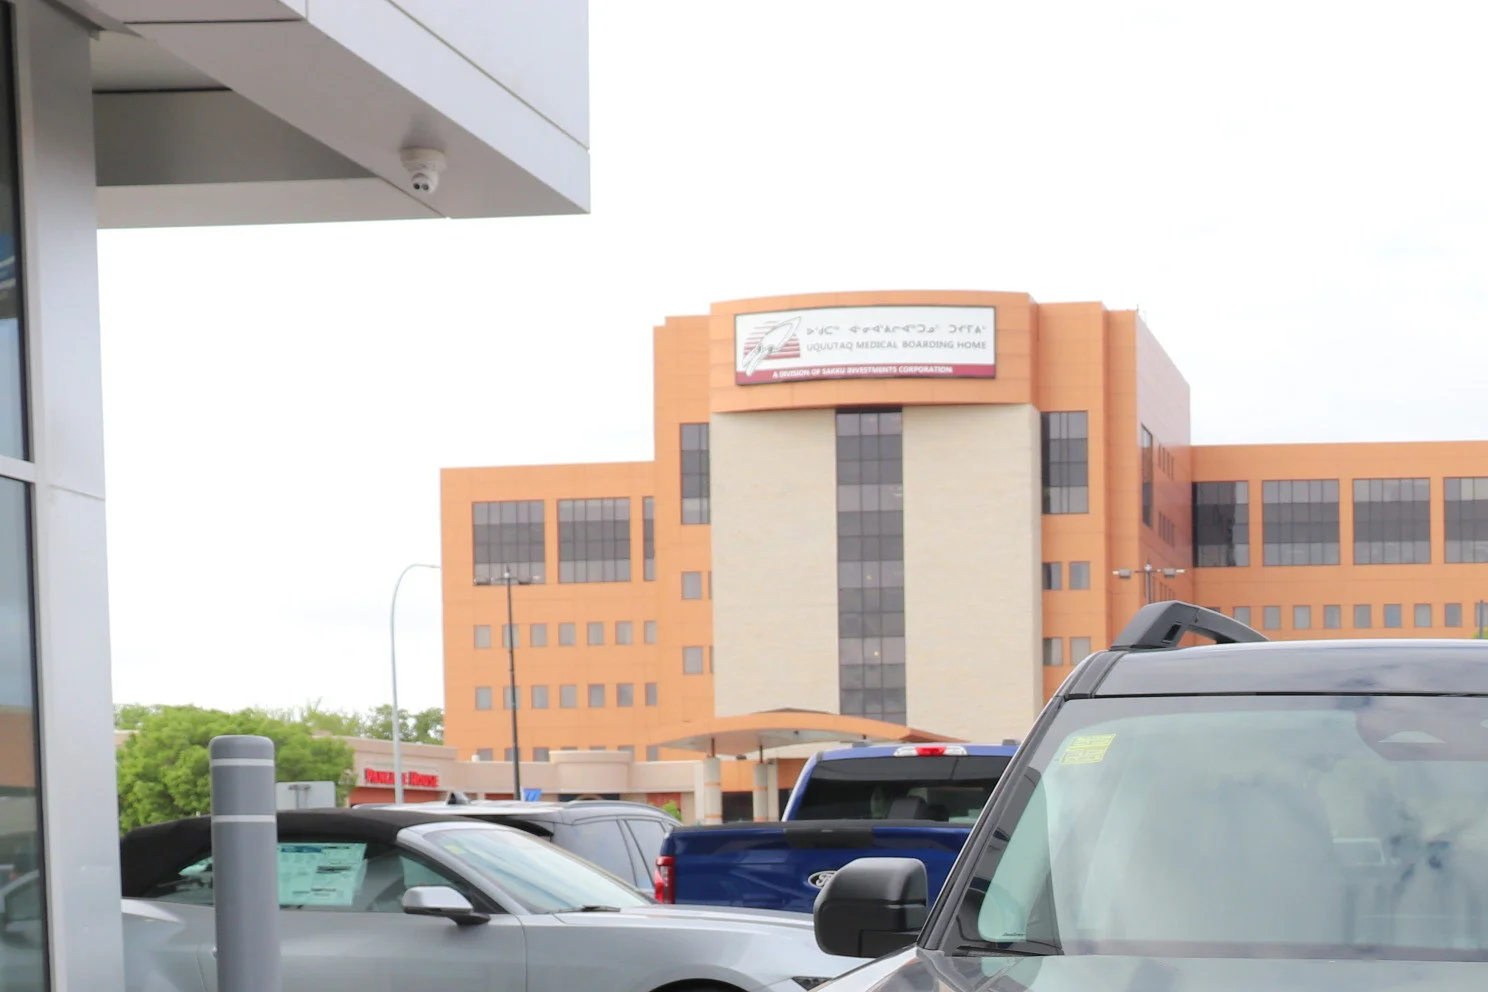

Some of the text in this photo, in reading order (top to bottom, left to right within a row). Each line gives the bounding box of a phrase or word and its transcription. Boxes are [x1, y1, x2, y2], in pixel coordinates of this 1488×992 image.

[855, 340, 897, 350] MEDICAL
[902, 340, 955, 349] BOARDING
[957, 340, 987, 349] HOME
[772, 371, 779, 379] A
[779, 369, 810, 378] DIVISION
[811, 368, 821, 376] OF
[364, 767, 439, 787] PANCAE HOUSE
